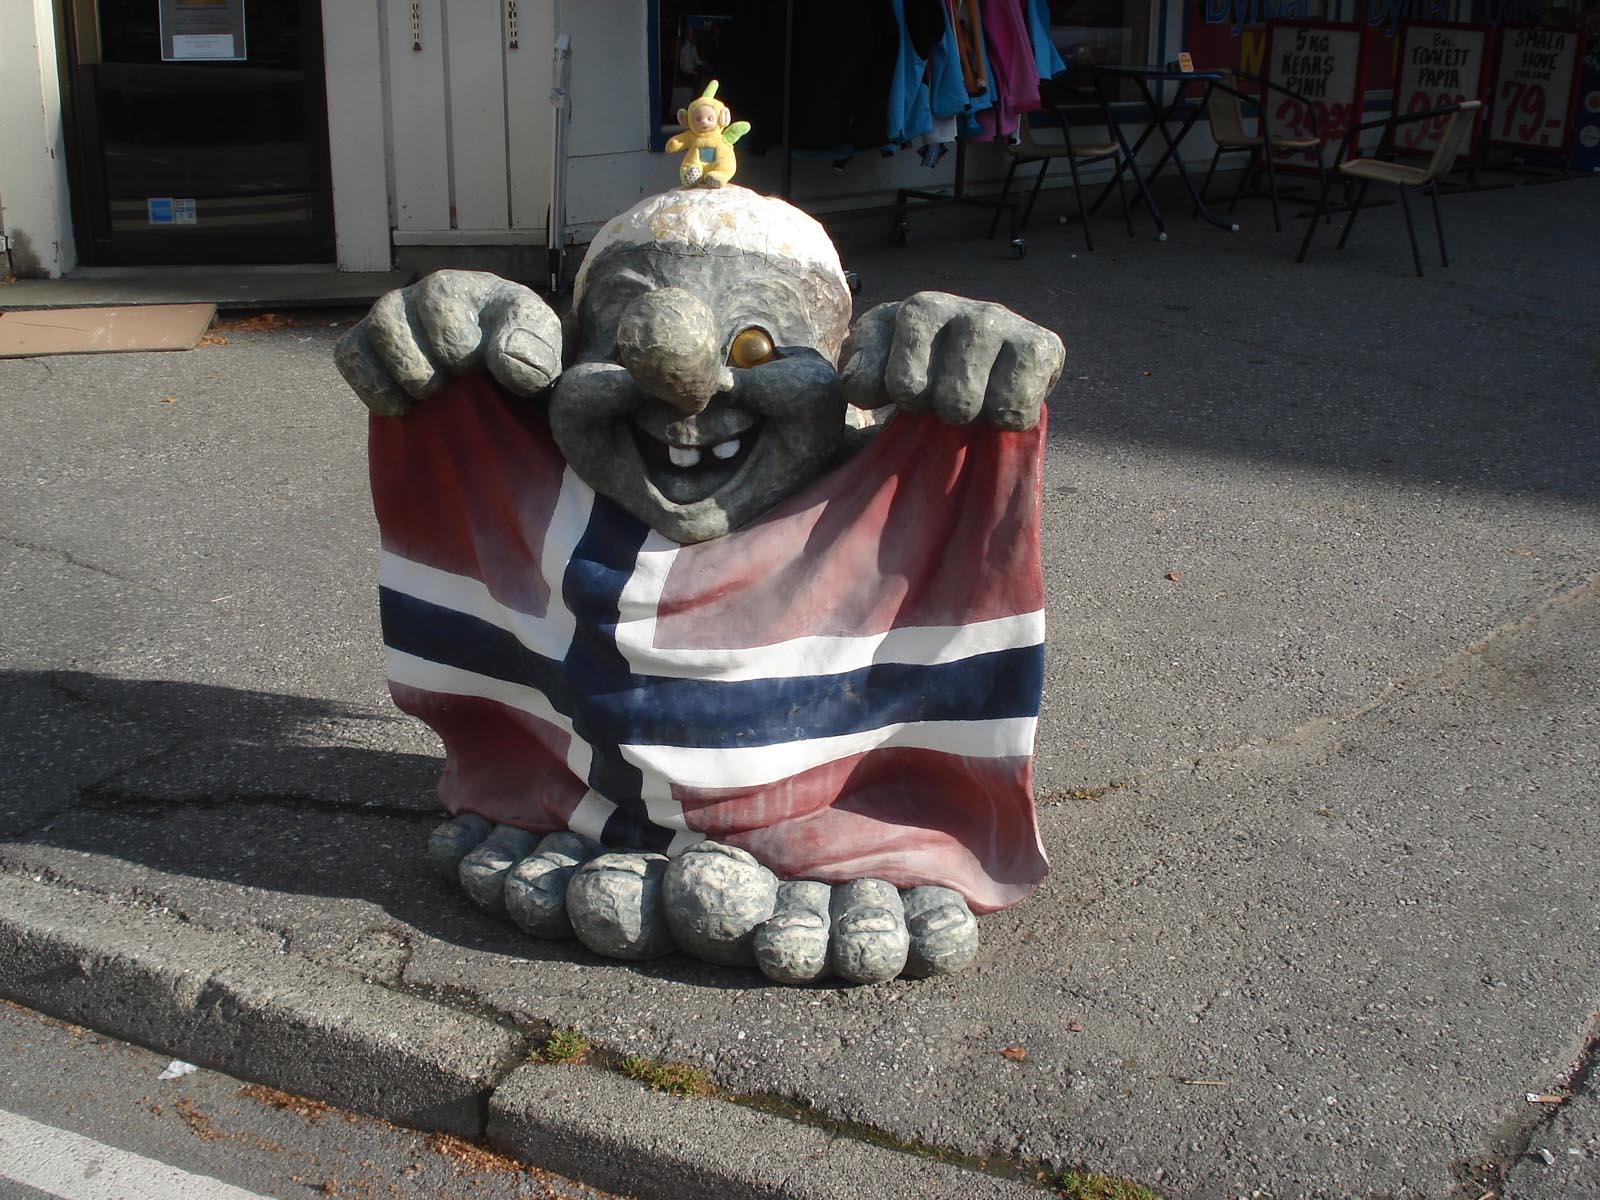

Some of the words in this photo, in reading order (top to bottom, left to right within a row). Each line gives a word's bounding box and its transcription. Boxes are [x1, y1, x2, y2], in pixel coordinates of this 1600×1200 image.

[1296, 30, 1306, 51] 5
[1310, 35, 1329, 53] KG
[1514, 32, 1565, 50] SMALA
[1411, 47, 1472, 67] TOALETT
[1521, 51, 1559, 71] HOVE
[1286, 77, 1327, 97] PINK
[1418, 67, 1460, 88] PAPIR
